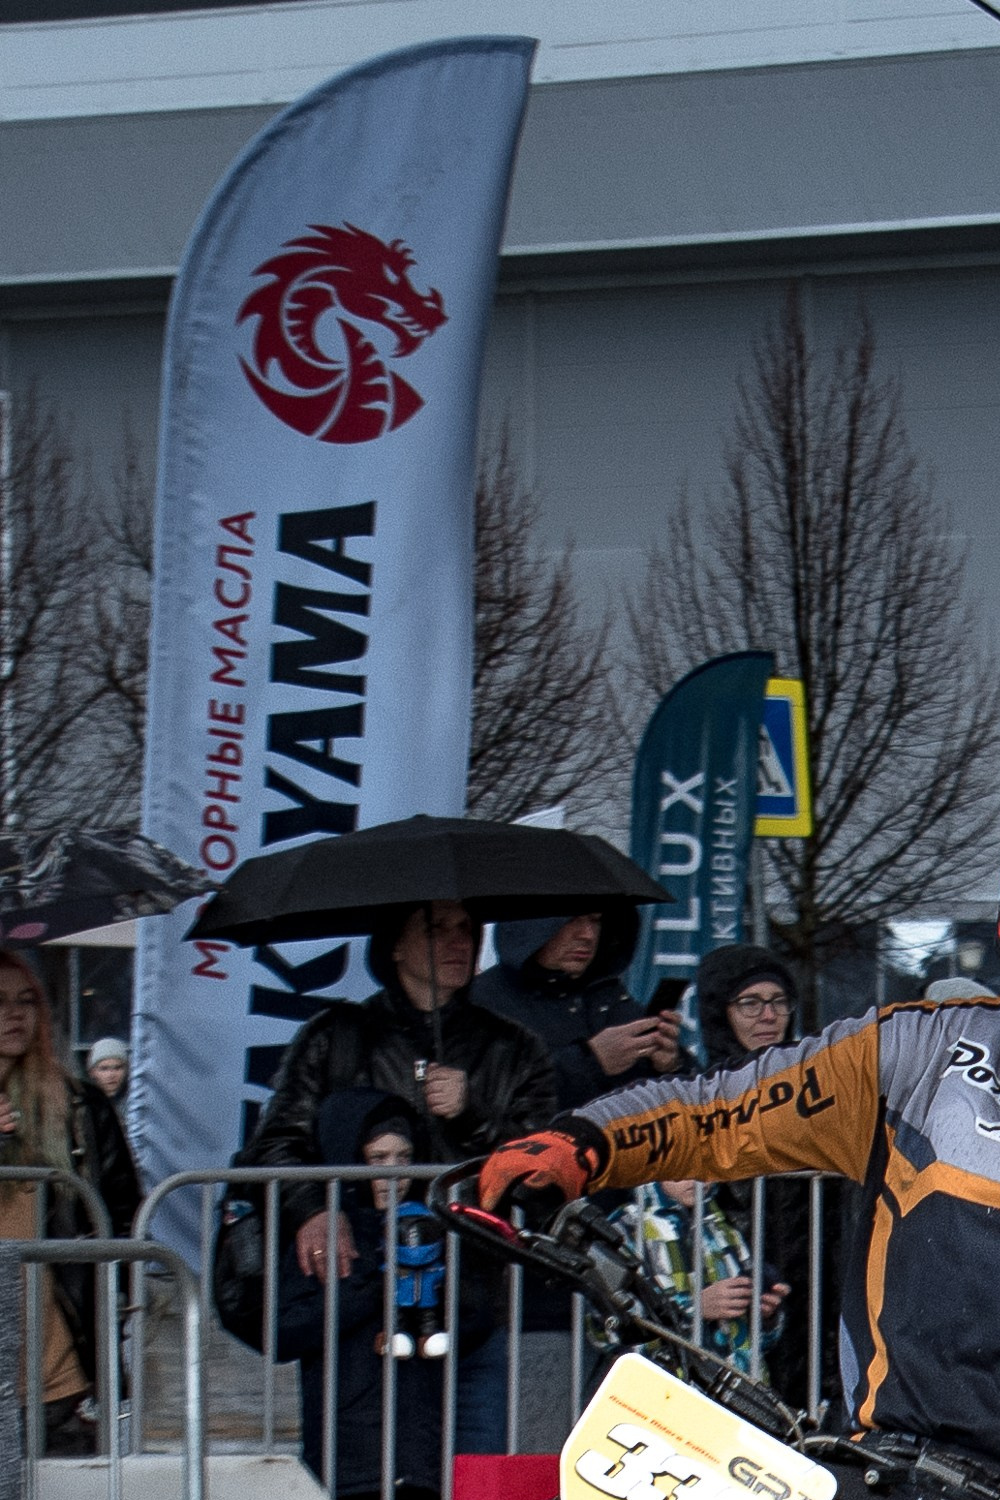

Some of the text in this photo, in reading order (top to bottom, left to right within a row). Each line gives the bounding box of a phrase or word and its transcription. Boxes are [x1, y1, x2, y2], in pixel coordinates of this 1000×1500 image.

[191, 510, 256, 980] МОРНЫЕ МАСЛА
[240, 500, 377, 1148] KYAMA
[710, 776, 739, 940] КТИВНЫХ
